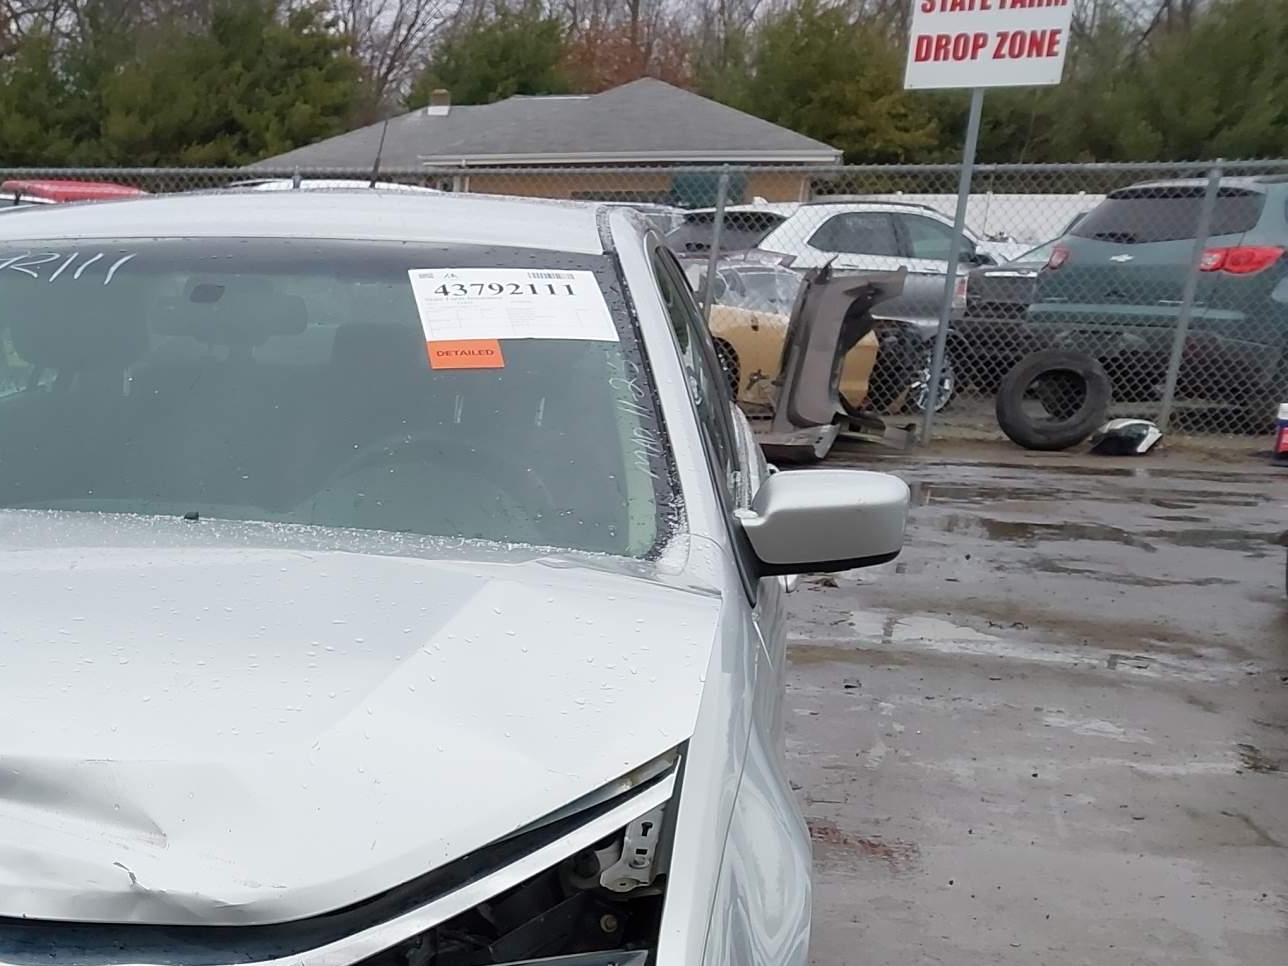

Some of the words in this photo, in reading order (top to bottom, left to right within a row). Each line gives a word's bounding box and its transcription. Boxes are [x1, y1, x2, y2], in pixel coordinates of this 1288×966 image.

[914, 33, 989, 62] DROP
[992, 29, 1062, 59] ZONE
[433, 282, 577, 297] 43792111
[436, 349, 495, 358] DETAILED
